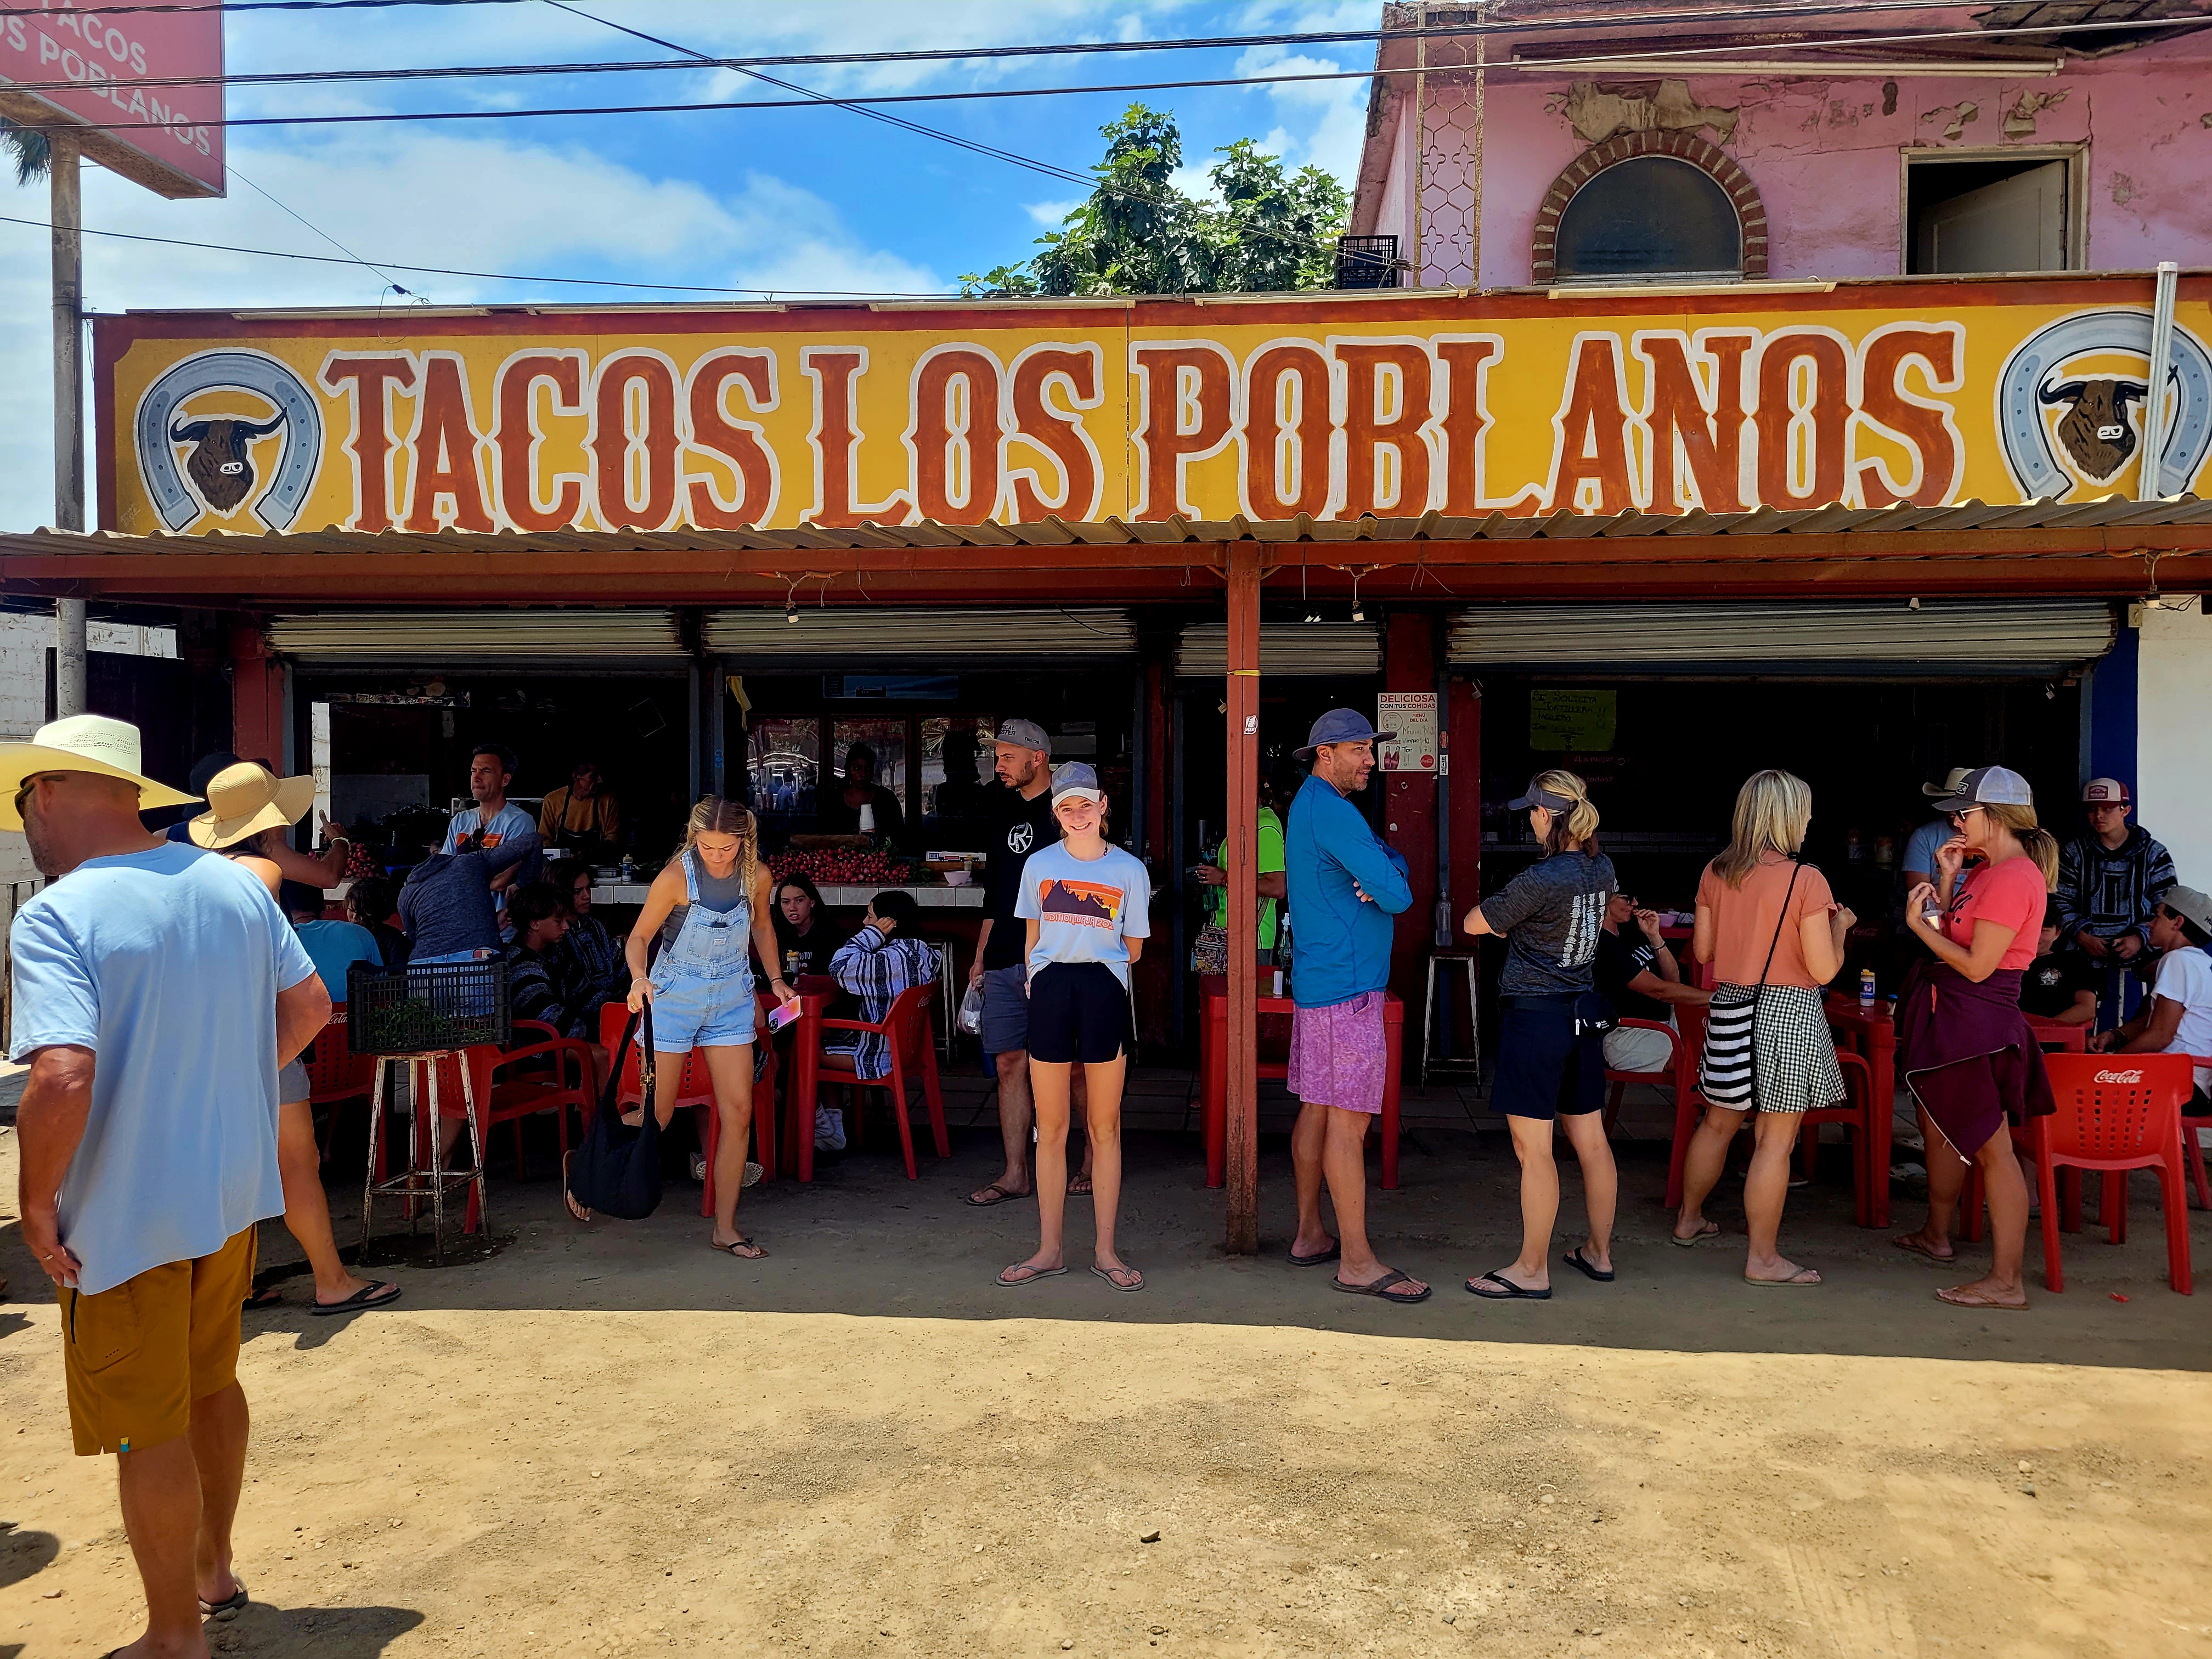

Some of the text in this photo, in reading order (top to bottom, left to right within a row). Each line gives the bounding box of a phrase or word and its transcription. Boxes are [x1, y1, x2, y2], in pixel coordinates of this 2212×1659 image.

[40, 31, 211, 156] POBLANOS
[317, 321, 1965, 534] TACOS LOS POBLANOS
[1380, 694, 1436, 703] DELICIOSA
[2093, 1069, 2144, 1084] Coca-Cola
